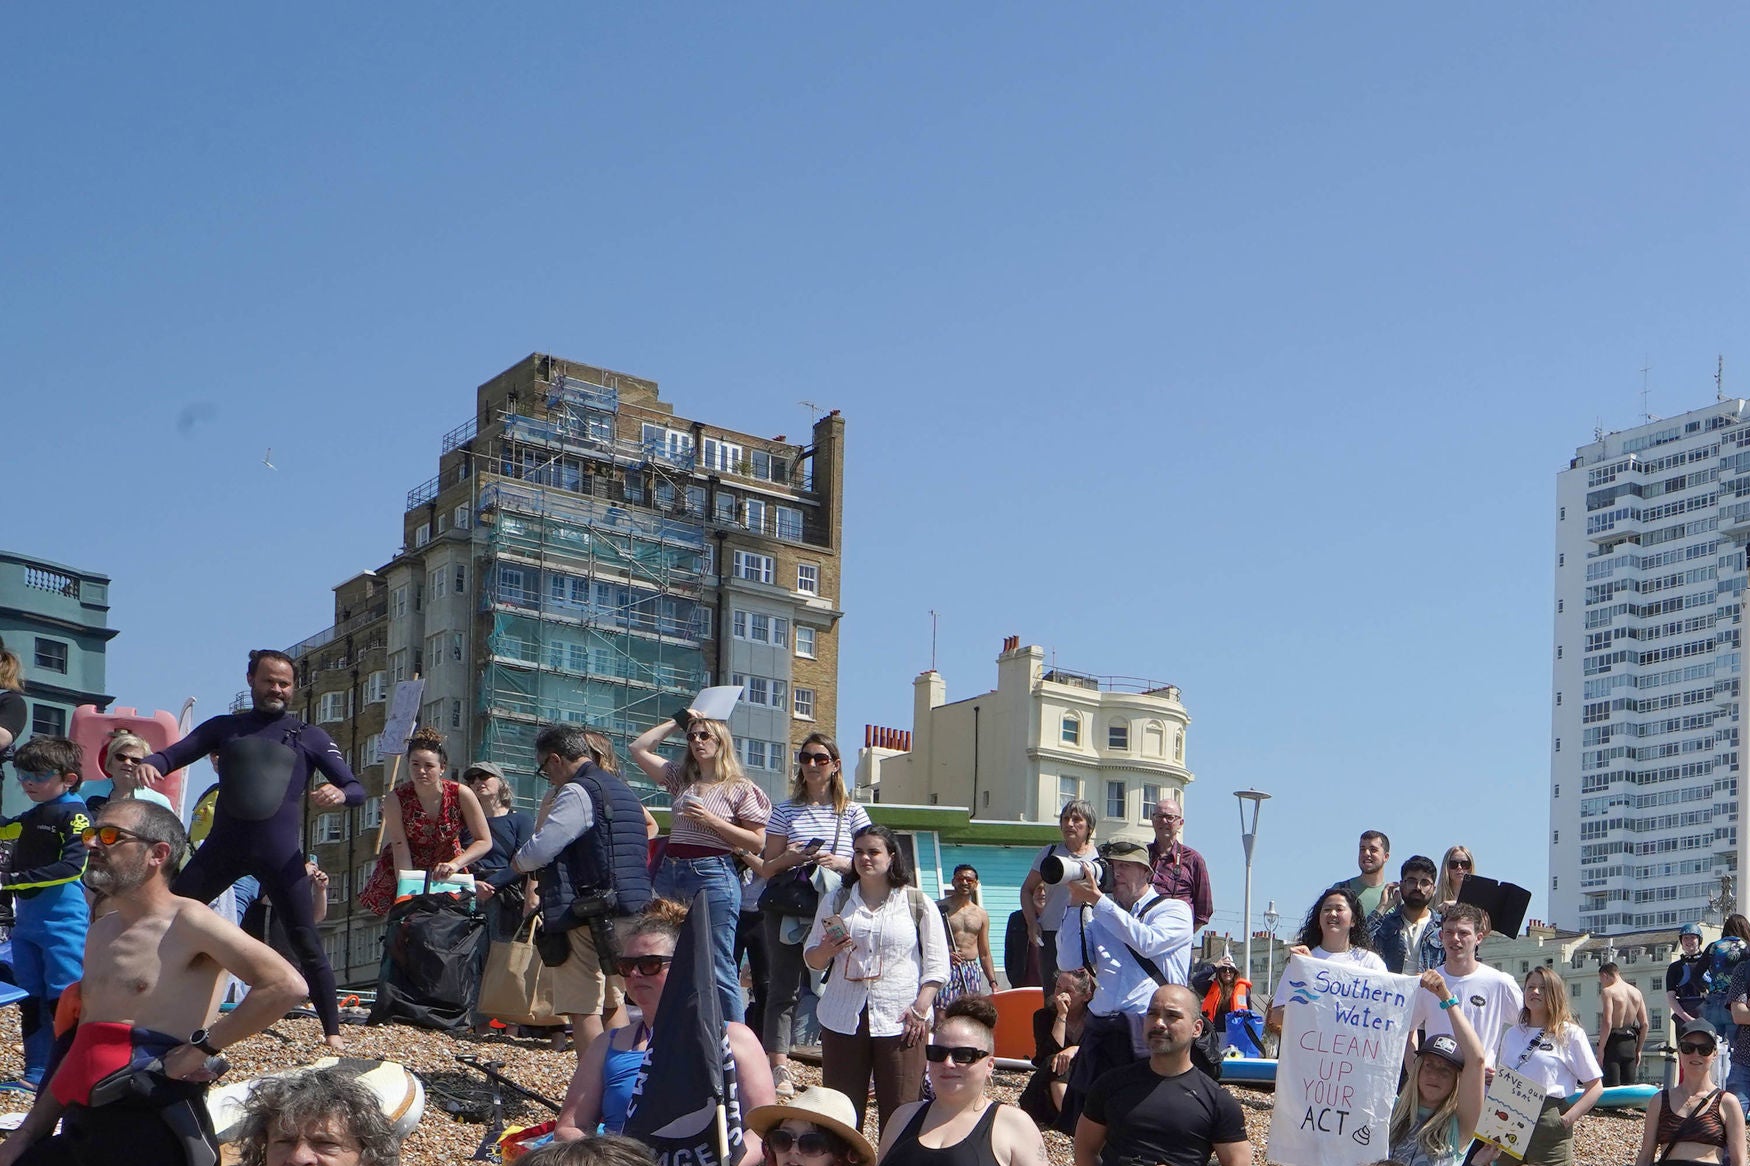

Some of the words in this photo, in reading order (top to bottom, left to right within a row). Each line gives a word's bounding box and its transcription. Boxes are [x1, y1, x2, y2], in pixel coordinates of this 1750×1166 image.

[1313, 970, 1406, 1008] Southern
[1334, 1001, 1396, 1032] Water
[1299, 1030, 1380, 1060] CLEAN
[1319, 1058, 1353, 1082] UP
[1498, 1068, 1523, 1089] SAVE
[1302, 1078, 1355, 1109] YOUR
[1300, 1105, 1350, 1136] ACT
